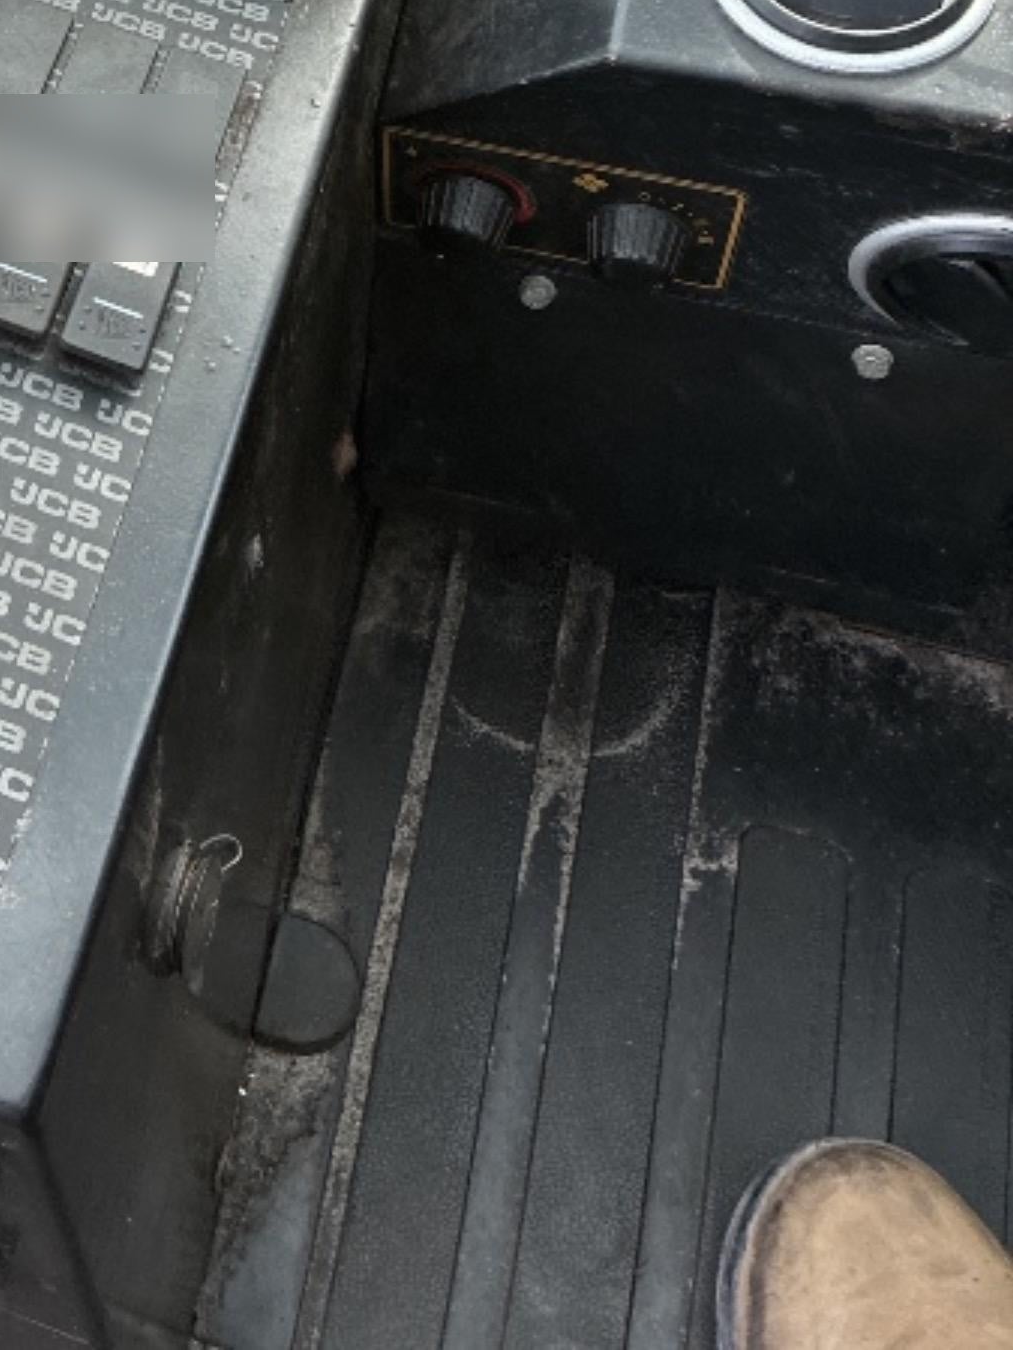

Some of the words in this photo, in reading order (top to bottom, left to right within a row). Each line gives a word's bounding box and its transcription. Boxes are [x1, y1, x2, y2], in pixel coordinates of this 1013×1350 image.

[92, 2, 166, 40] JCB
[179, 32, 255, 69] JCB
[230, 24, 279, 50] JC
[35, 412, 122, 462] JCB
[98, 399, 152, 436] JC
[11, 478, 101, 528] JCB
[74, 463, 131, 503] JC
[50, 531, 110, 573] JC
[24, 602, 86, 645] JC
